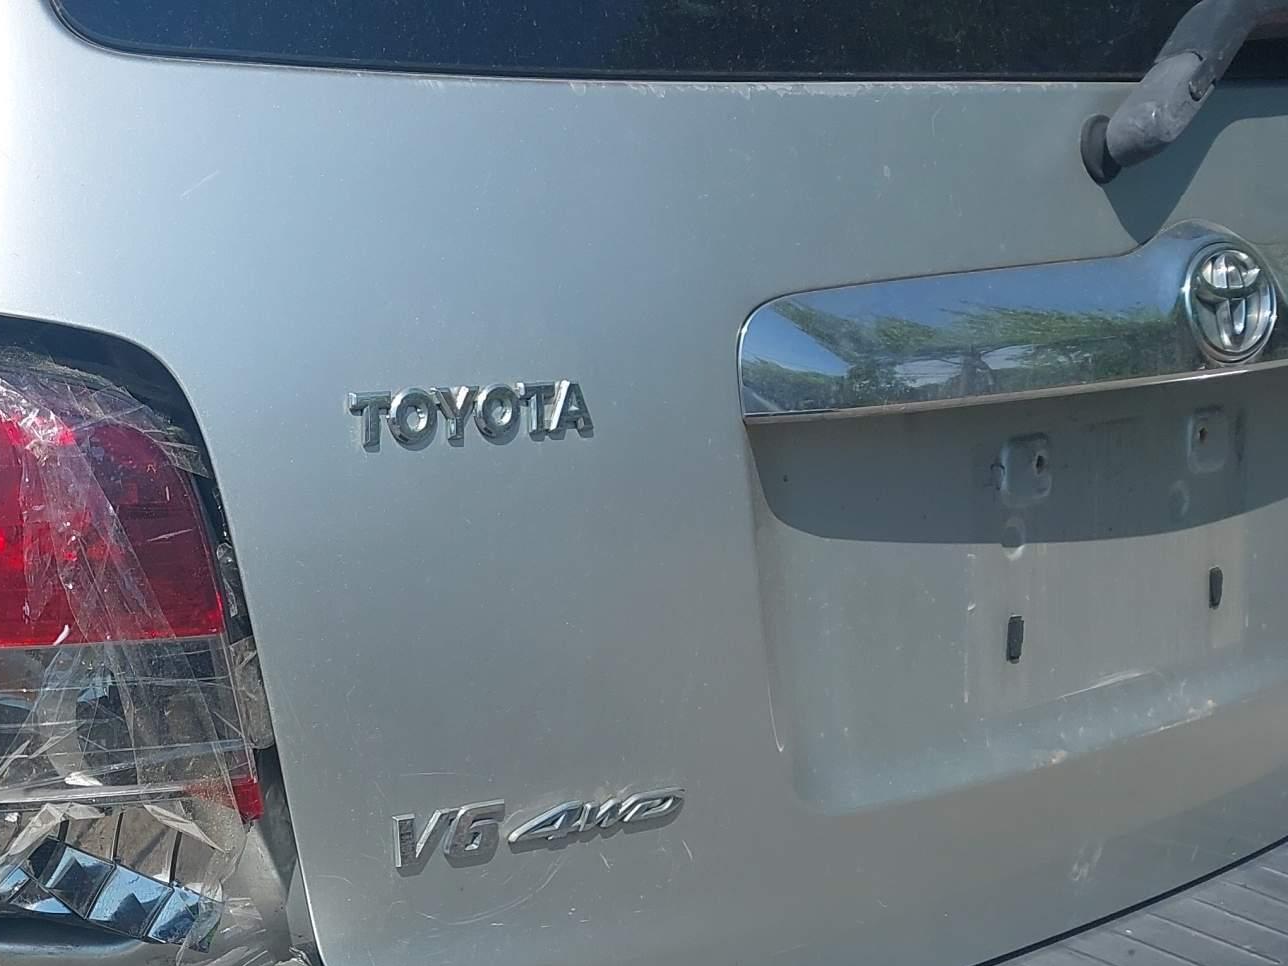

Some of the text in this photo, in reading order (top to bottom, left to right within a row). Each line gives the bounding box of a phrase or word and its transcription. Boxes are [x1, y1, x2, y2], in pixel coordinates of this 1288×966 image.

[348, 379, 594, 451] TOYOTA
[392, 785, 686, 869] V6 4WD
